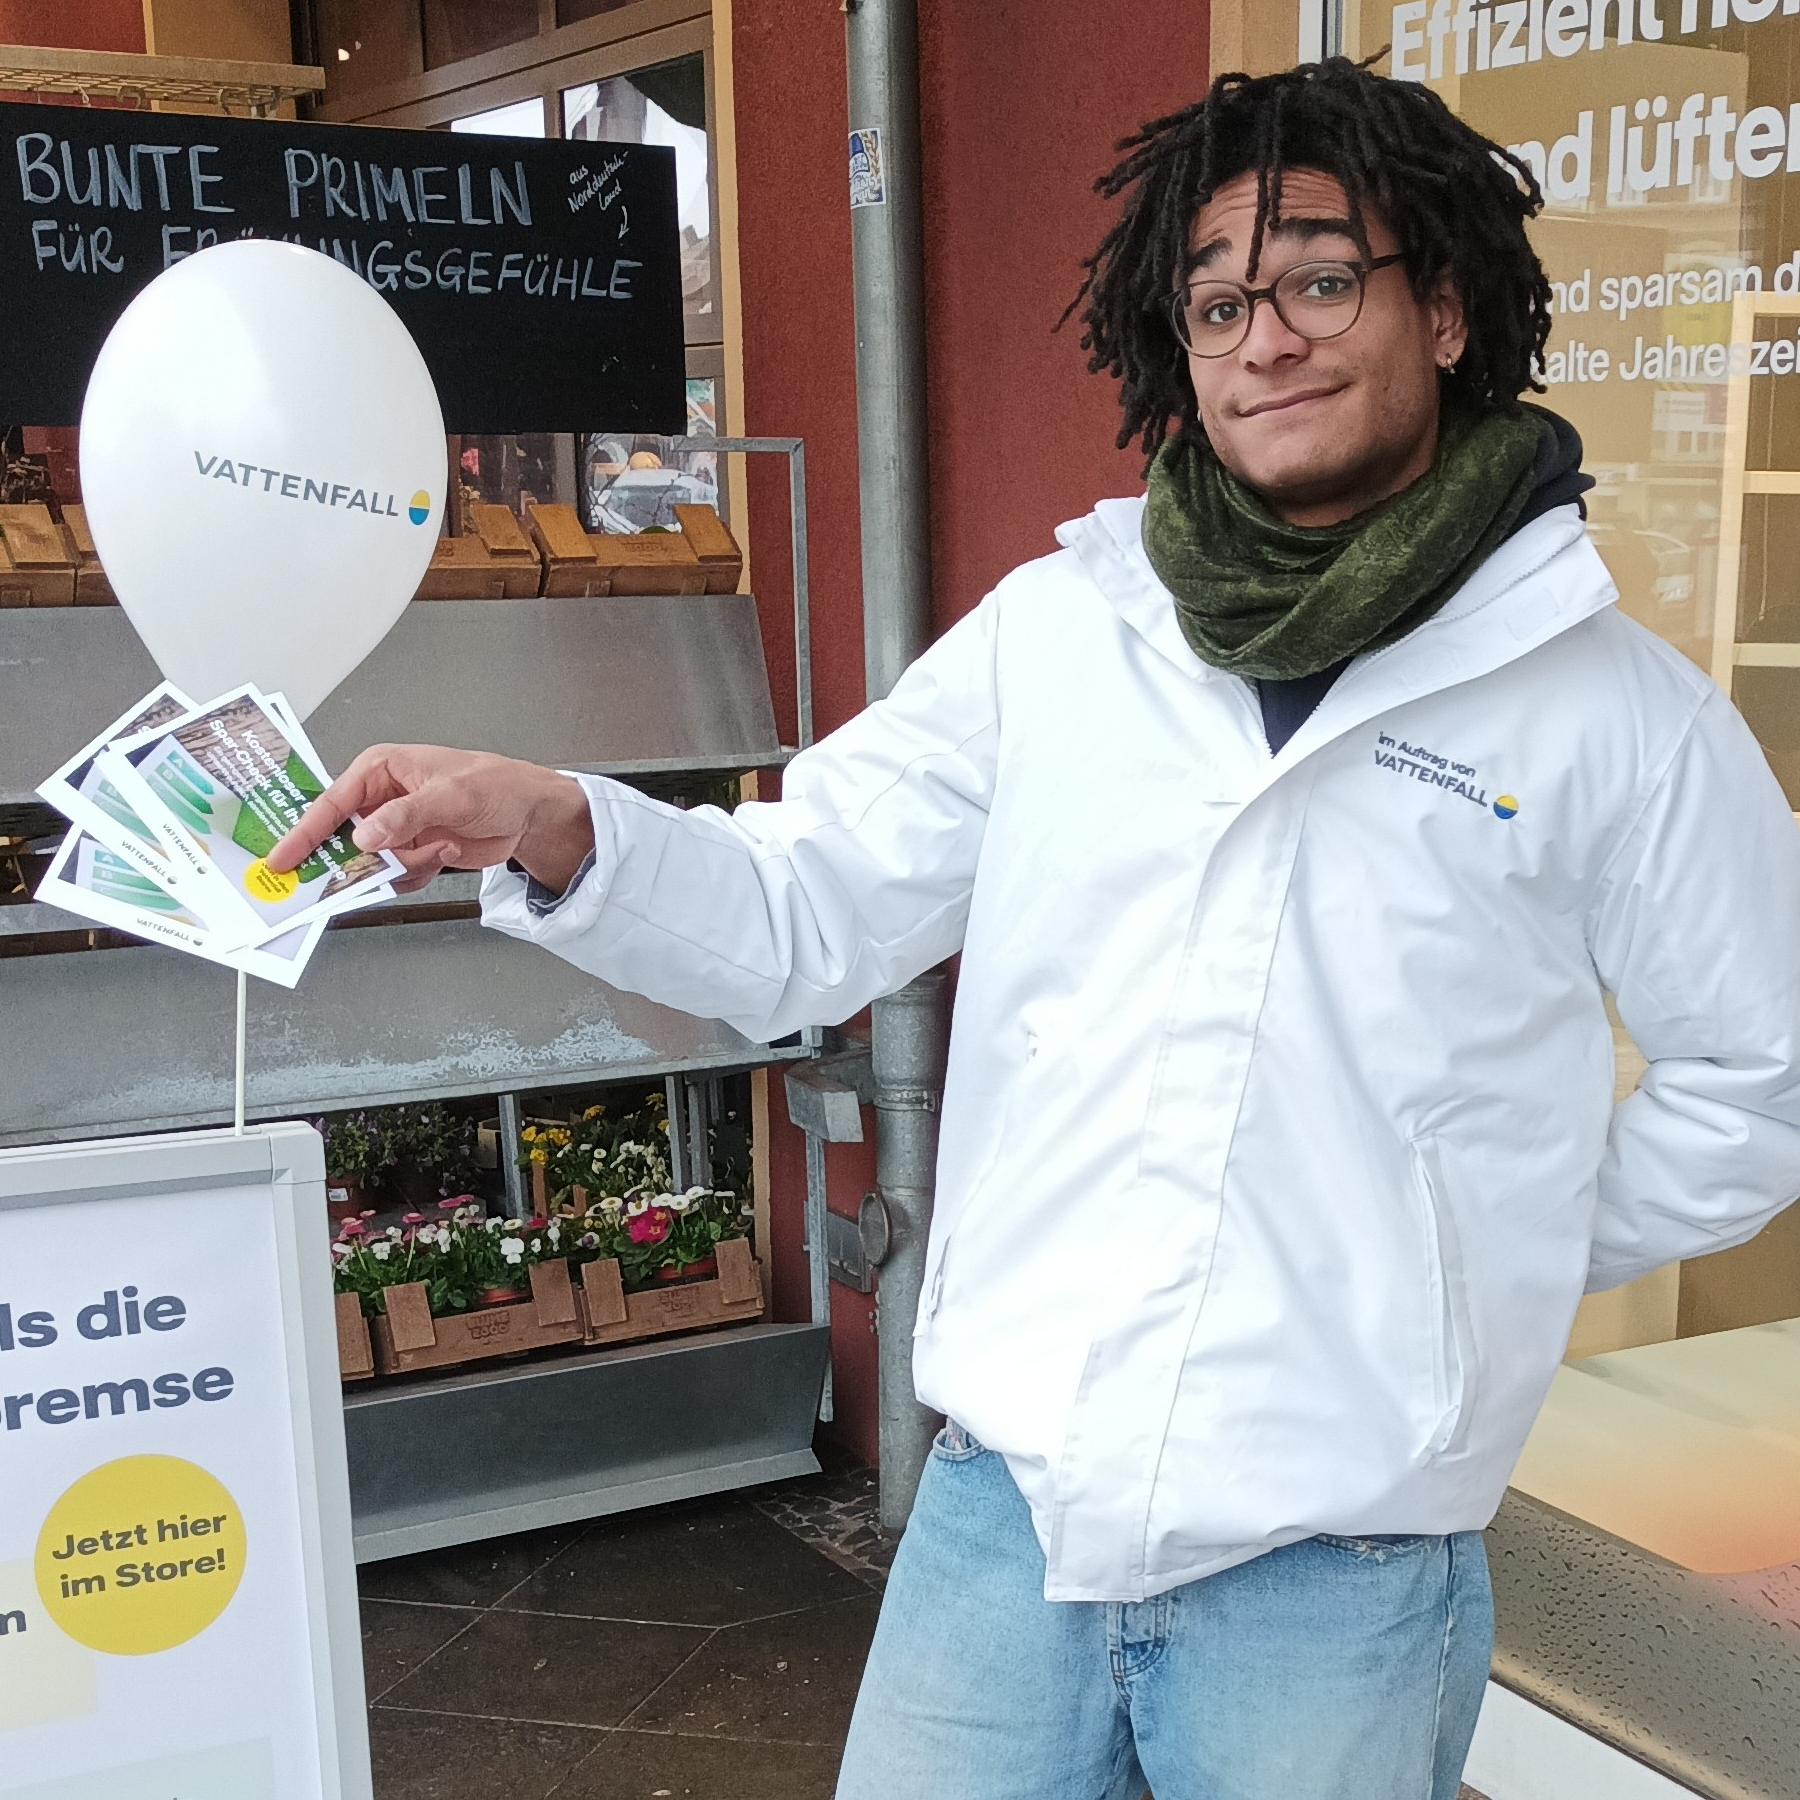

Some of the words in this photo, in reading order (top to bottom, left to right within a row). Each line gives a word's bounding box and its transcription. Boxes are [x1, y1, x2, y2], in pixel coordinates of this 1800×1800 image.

[1391, 0, 1664, 82] Effizient
[16, 132, 235, 214] BUNTE
[284, 147, 532, 226] PRIMELN
[1489, 110, 1593, 200] nd
[31, 219, 124, 275] FÜR
[1540, 268, 1592, 314] nd
[1598, 264, 1763, 322] sparsam
[193, 450, 399, 517] VATTENFALL
[1374, 750, 1488, 808] VATTENFALL
[1378, 731, 1396, 749] im
[1398, 741, 1449, 770] Auftrag
[1451, 761, 1476, 778] von
[121, 839, 168, 878] VATTENFALL
[162, 823, 199, 867] VATTENFALL
[136, 917, 190, 942] VATTENFALL
[76, 1285, 187, 1341] die
[0, 1366, 235, 1431] remse
[51, 1523, 148, 1560] Jetzt
[156, 1511, 227, 1543] hier
[60, 1573, 106, 1598] im
[115, 1548, 226, 1590] Store!
